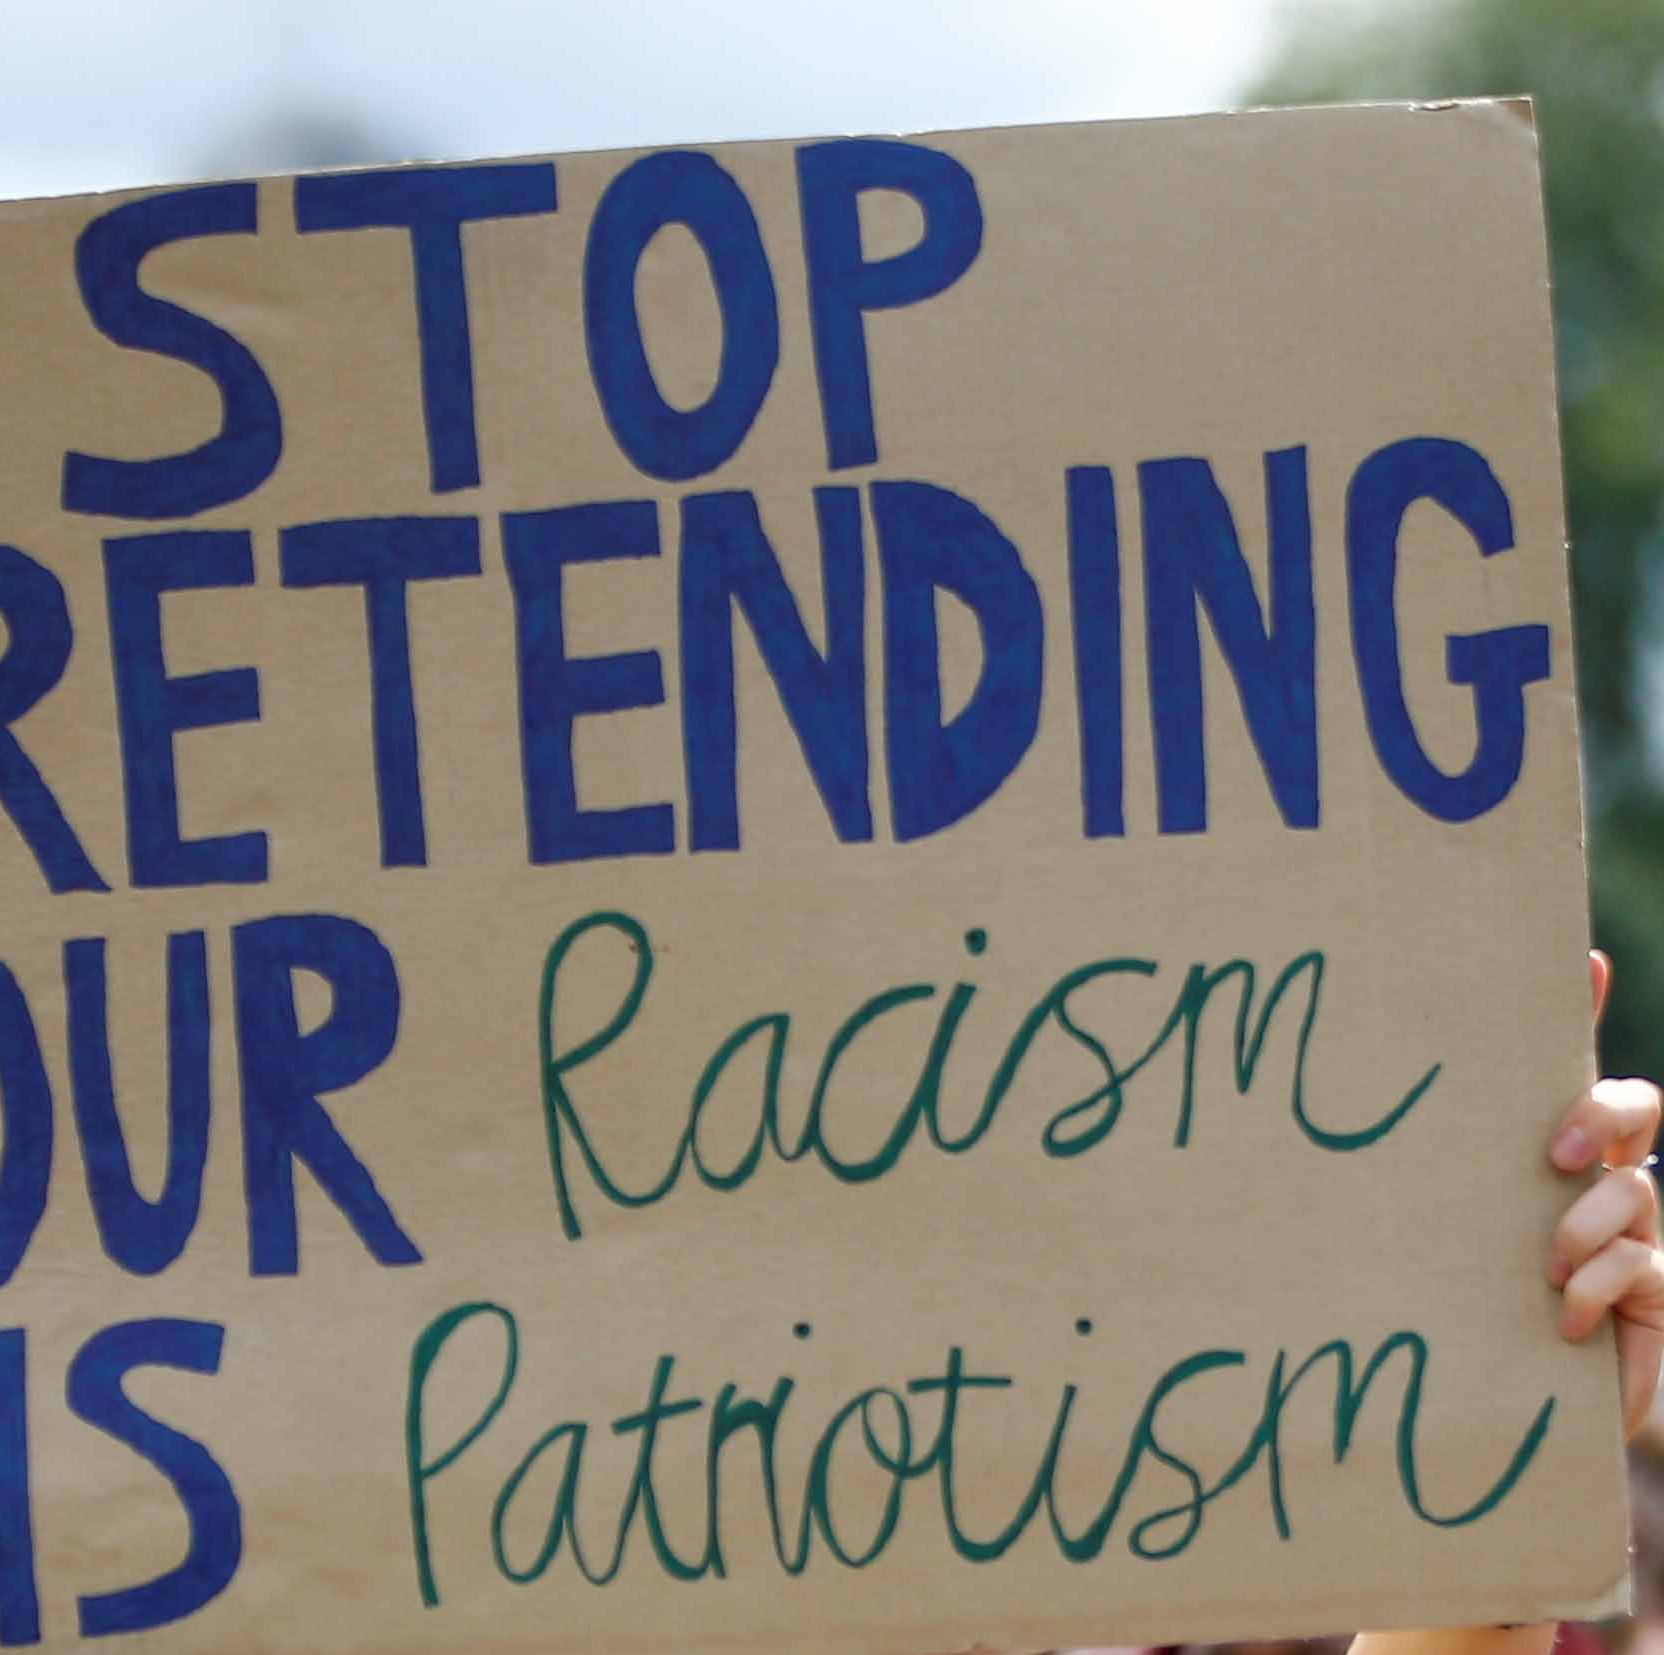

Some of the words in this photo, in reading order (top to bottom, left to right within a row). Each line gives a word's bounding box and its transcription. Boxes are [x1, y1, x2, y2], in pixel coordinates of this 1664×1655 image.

[63, 138, 983, 518] STOP
[537, 911, 1440, 1242] Racism
[405, 1301, 1560, 1610] Patriotism
